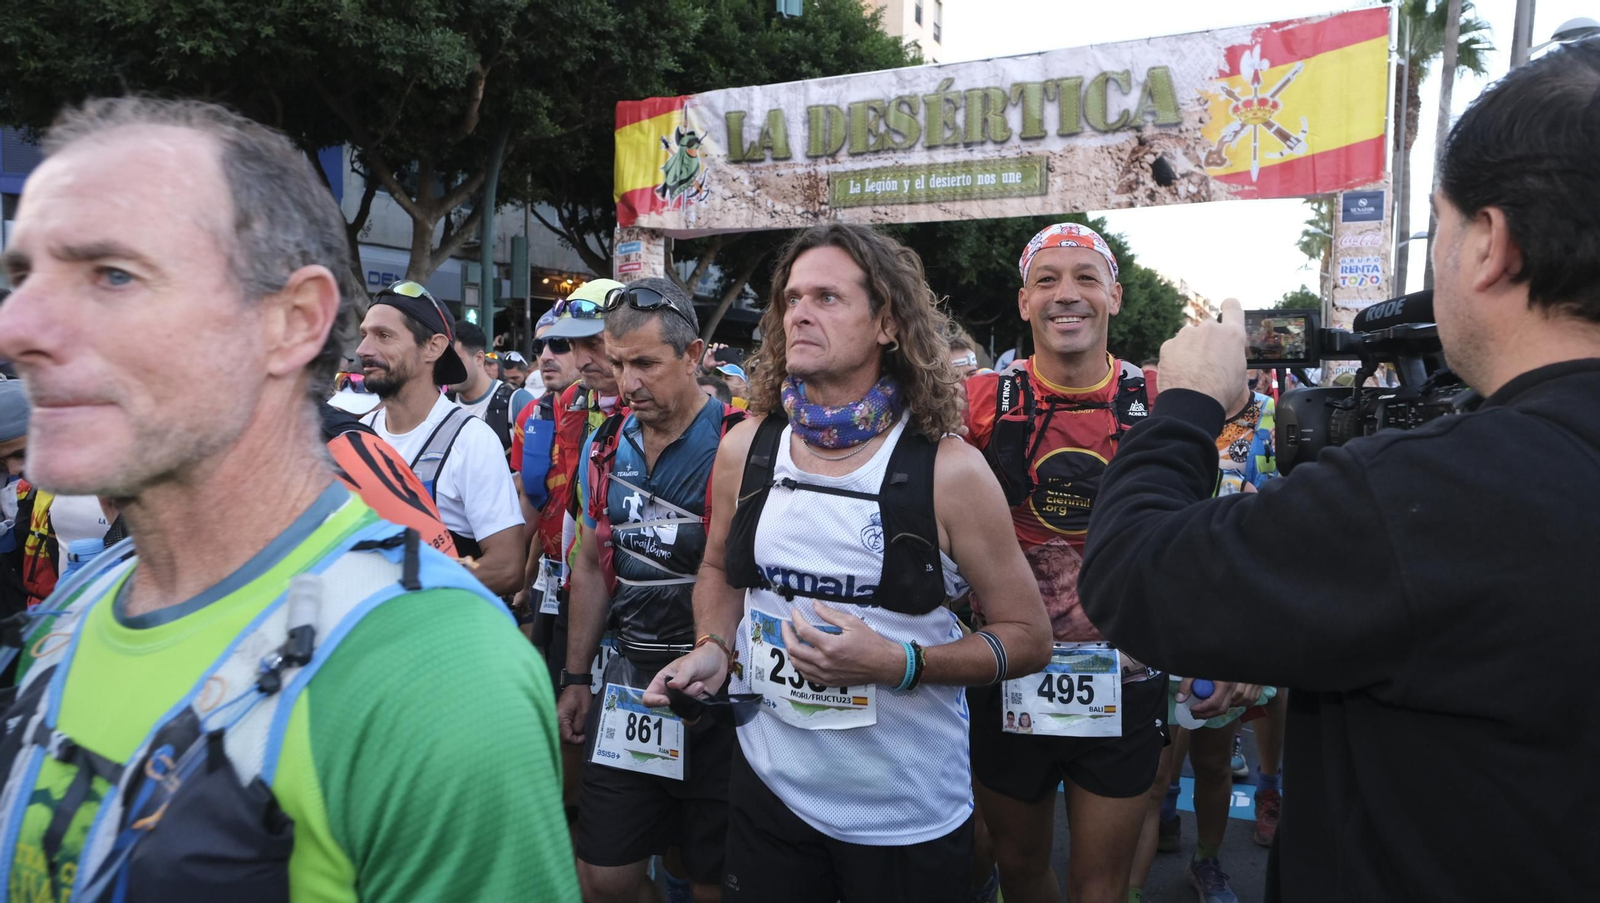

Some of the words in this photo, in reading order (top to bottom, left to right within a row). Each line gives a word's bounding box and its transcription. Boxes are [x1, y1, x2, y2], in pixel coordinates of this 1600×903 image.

[725, 108, 793, 163] LA
[806, 65, 1183, 159] DESÉRTICA
[849, 180, 861, 194] La
[865, 177, 898, 194] Legión
[903, 179, 911, 192] y
[915, 175, 925, 189] el
[929, 173, 972, 188] desierto
[977, 173, 997, 185] nos
[1002, 172, 1022, 184] une
[1341, 265, 1380, 274] RENTA
[1340, 275, 1380, 286] TODO
[1336, 367, 1356, 375] prim
[1046, 496, 1091, 508] cienmil
[1043, 504, 1067, 516] .org
[1037, 674, 1095, 705] 495
[625, 712, 664, 746] 861
[597, 749, 616, 759] asisa
